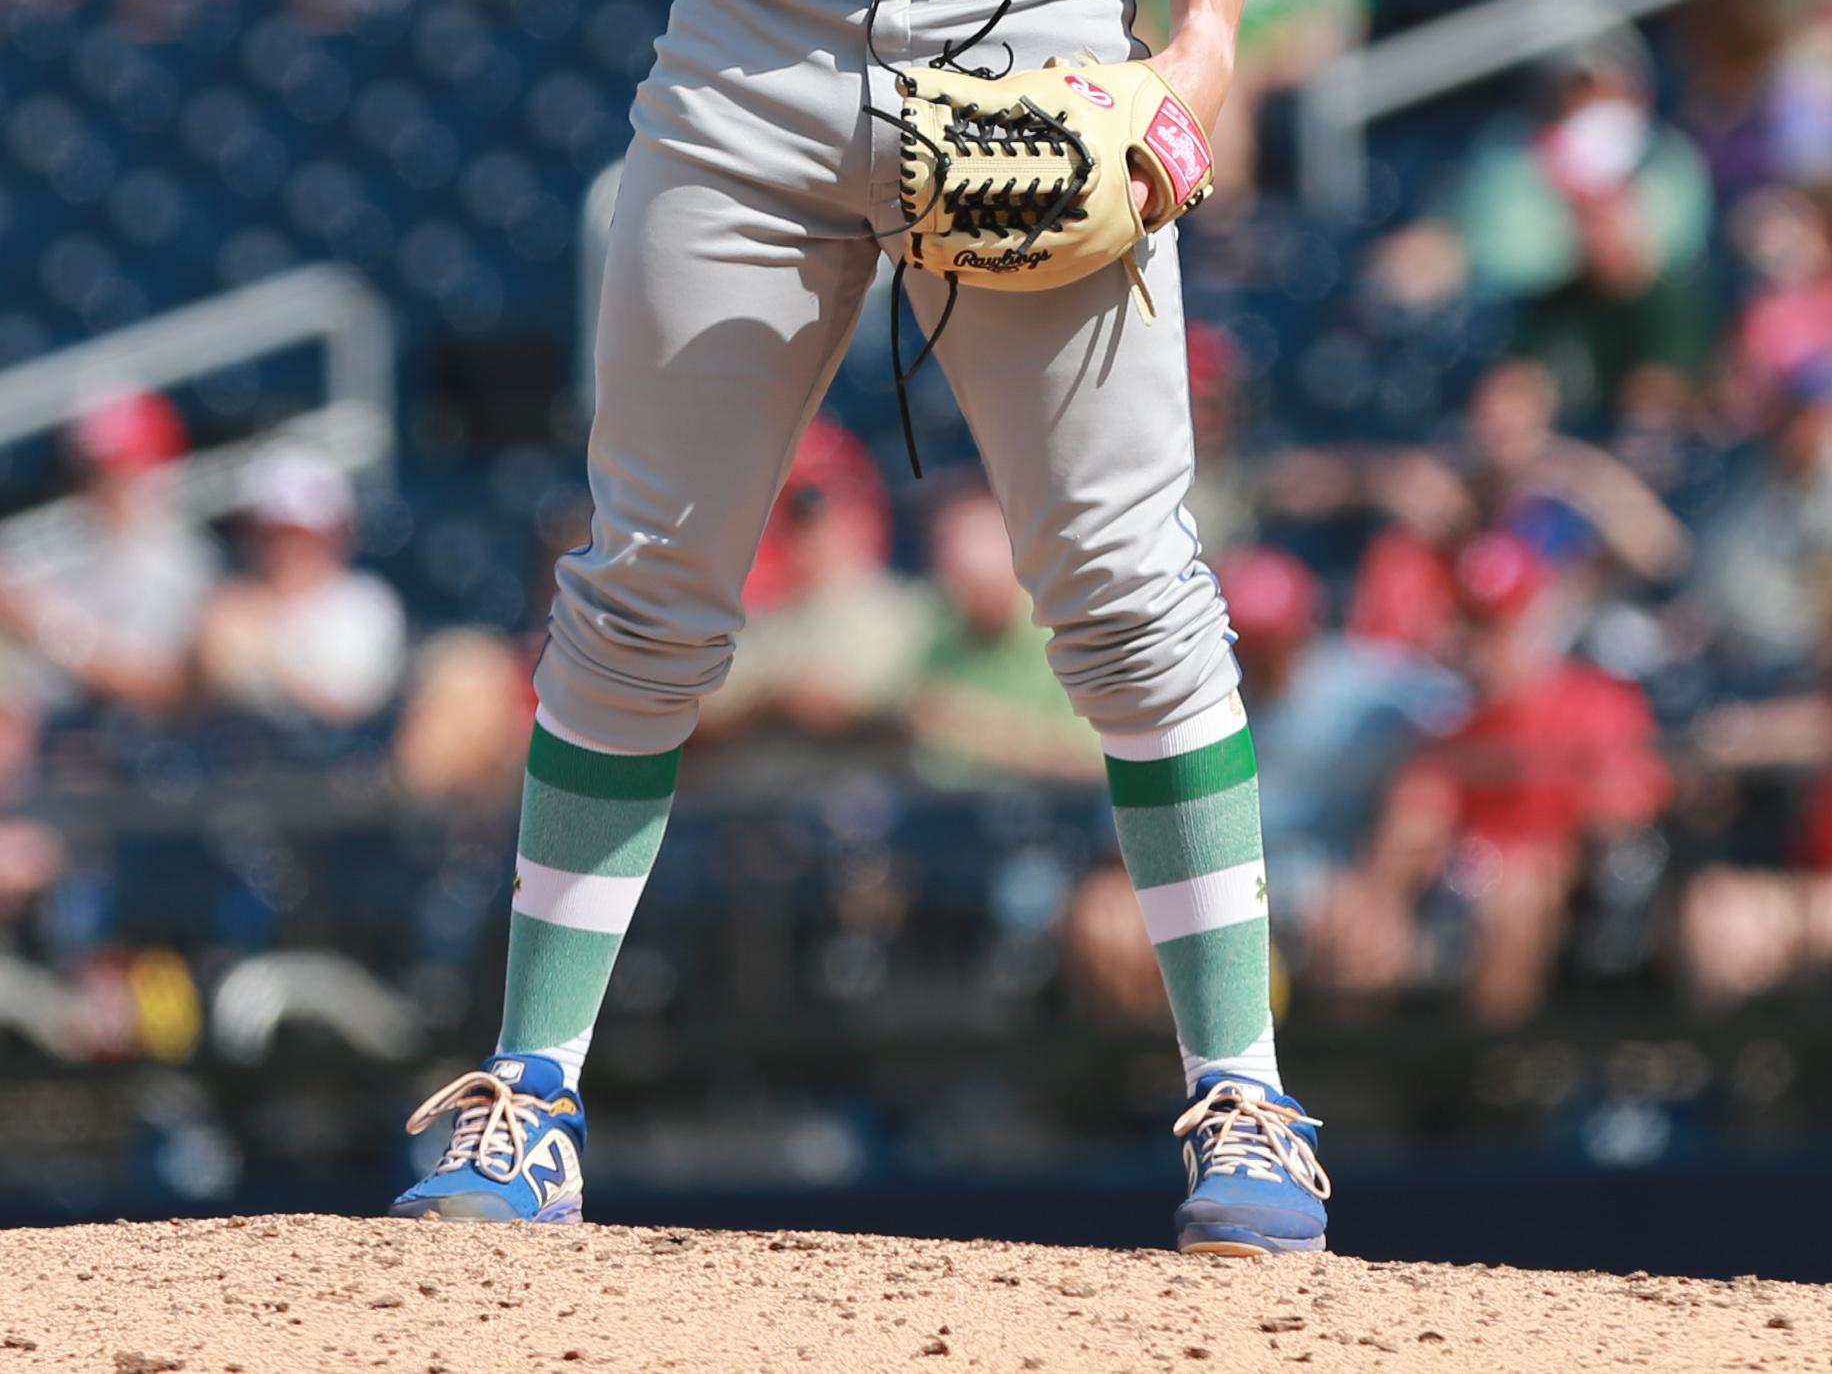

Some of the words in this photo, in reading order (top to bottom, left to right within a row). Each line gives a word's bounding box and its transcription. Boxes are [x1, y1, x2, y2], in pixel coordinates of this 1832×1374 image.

[1156, 125, 1200, 180] Rawlings
[953, 248, 1053, 272] Rawlings
[528, 1139, 567, 1207] N
